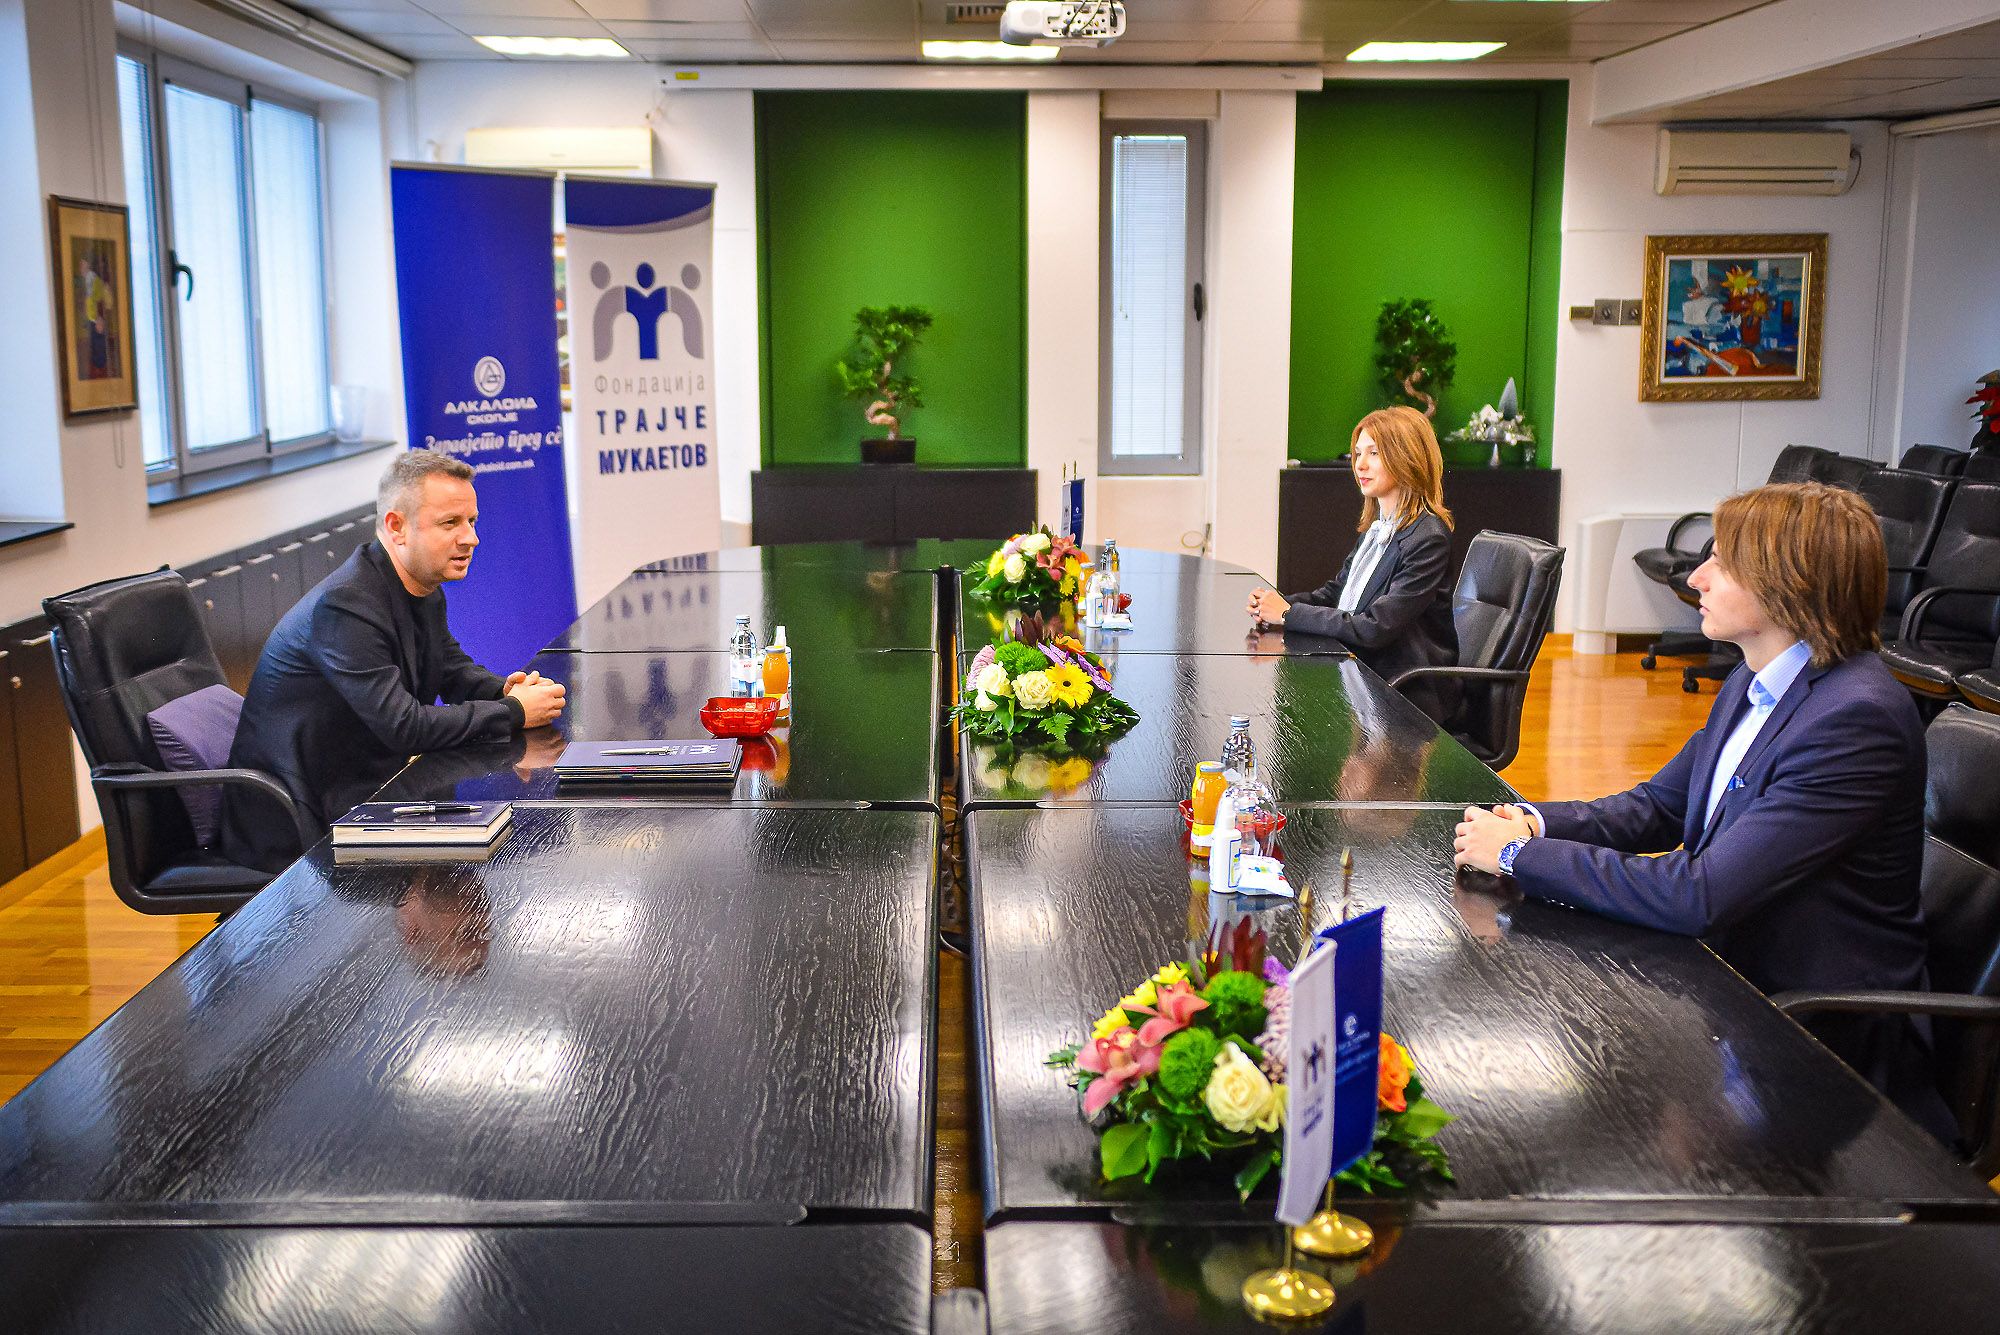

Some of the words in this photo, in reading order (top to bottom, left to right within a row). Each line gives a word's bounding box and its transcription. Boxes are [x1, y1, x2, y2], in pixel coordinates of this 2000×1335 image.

[594, 370, 705, 396] Фондација
[444, 396, 538, 414] АЛКАЛОИД
[466, 411, 518, 425] СКОПЈЕ
[596, 405, 707, 435] ТРАЈЧЕ
[507, 430, 543, 453] пред
[598, 443, 708, 475] МУКАЕТОВ
